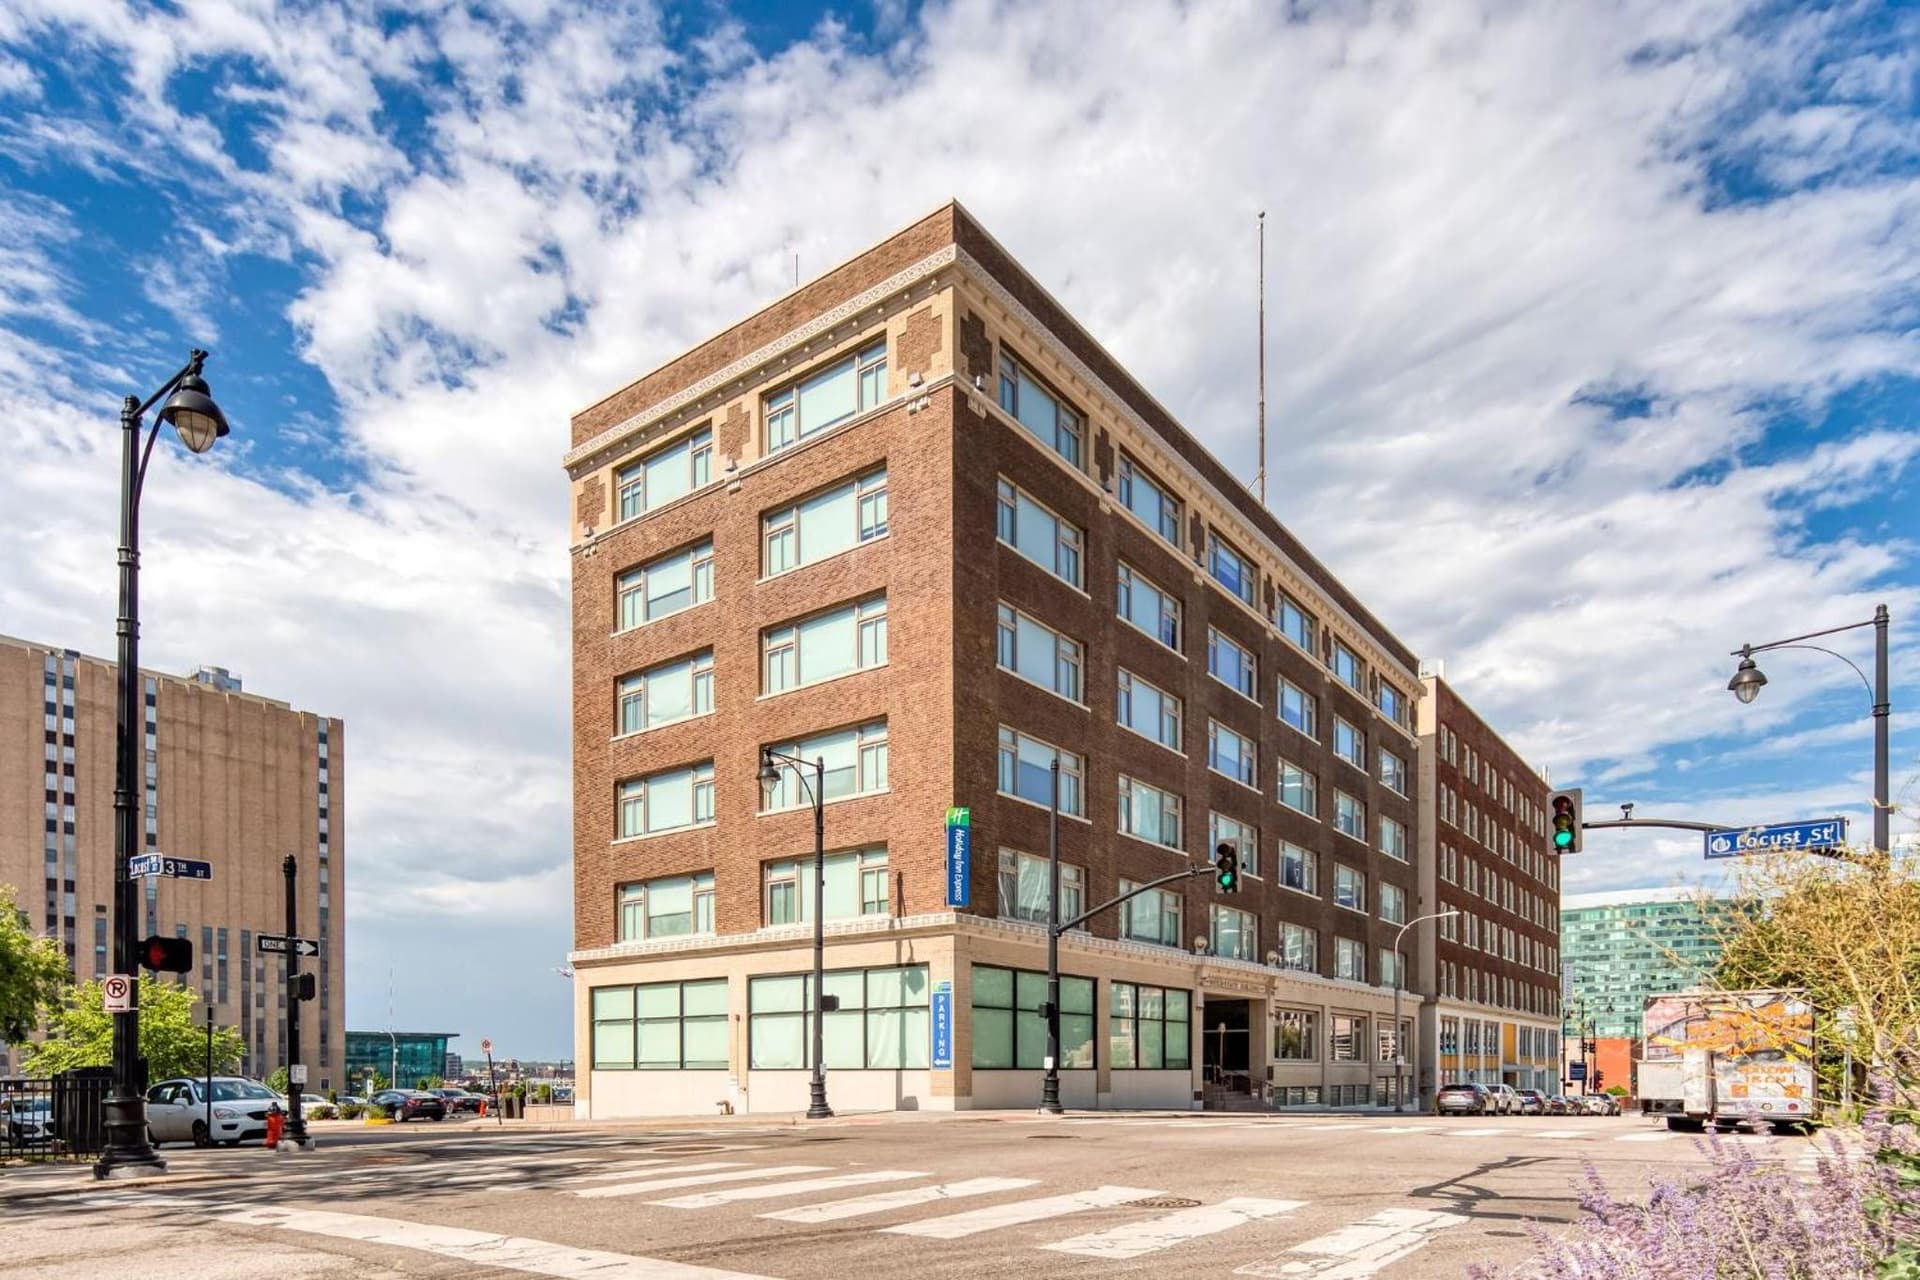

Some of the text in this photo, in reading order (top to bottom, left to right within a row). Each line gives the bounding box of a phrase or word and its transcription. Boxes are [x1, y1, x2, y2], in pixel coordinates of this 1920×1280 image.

[1735, 826, 1832, 849] Locust St
[953, 829, 965, 902] Holiday Inn Express
